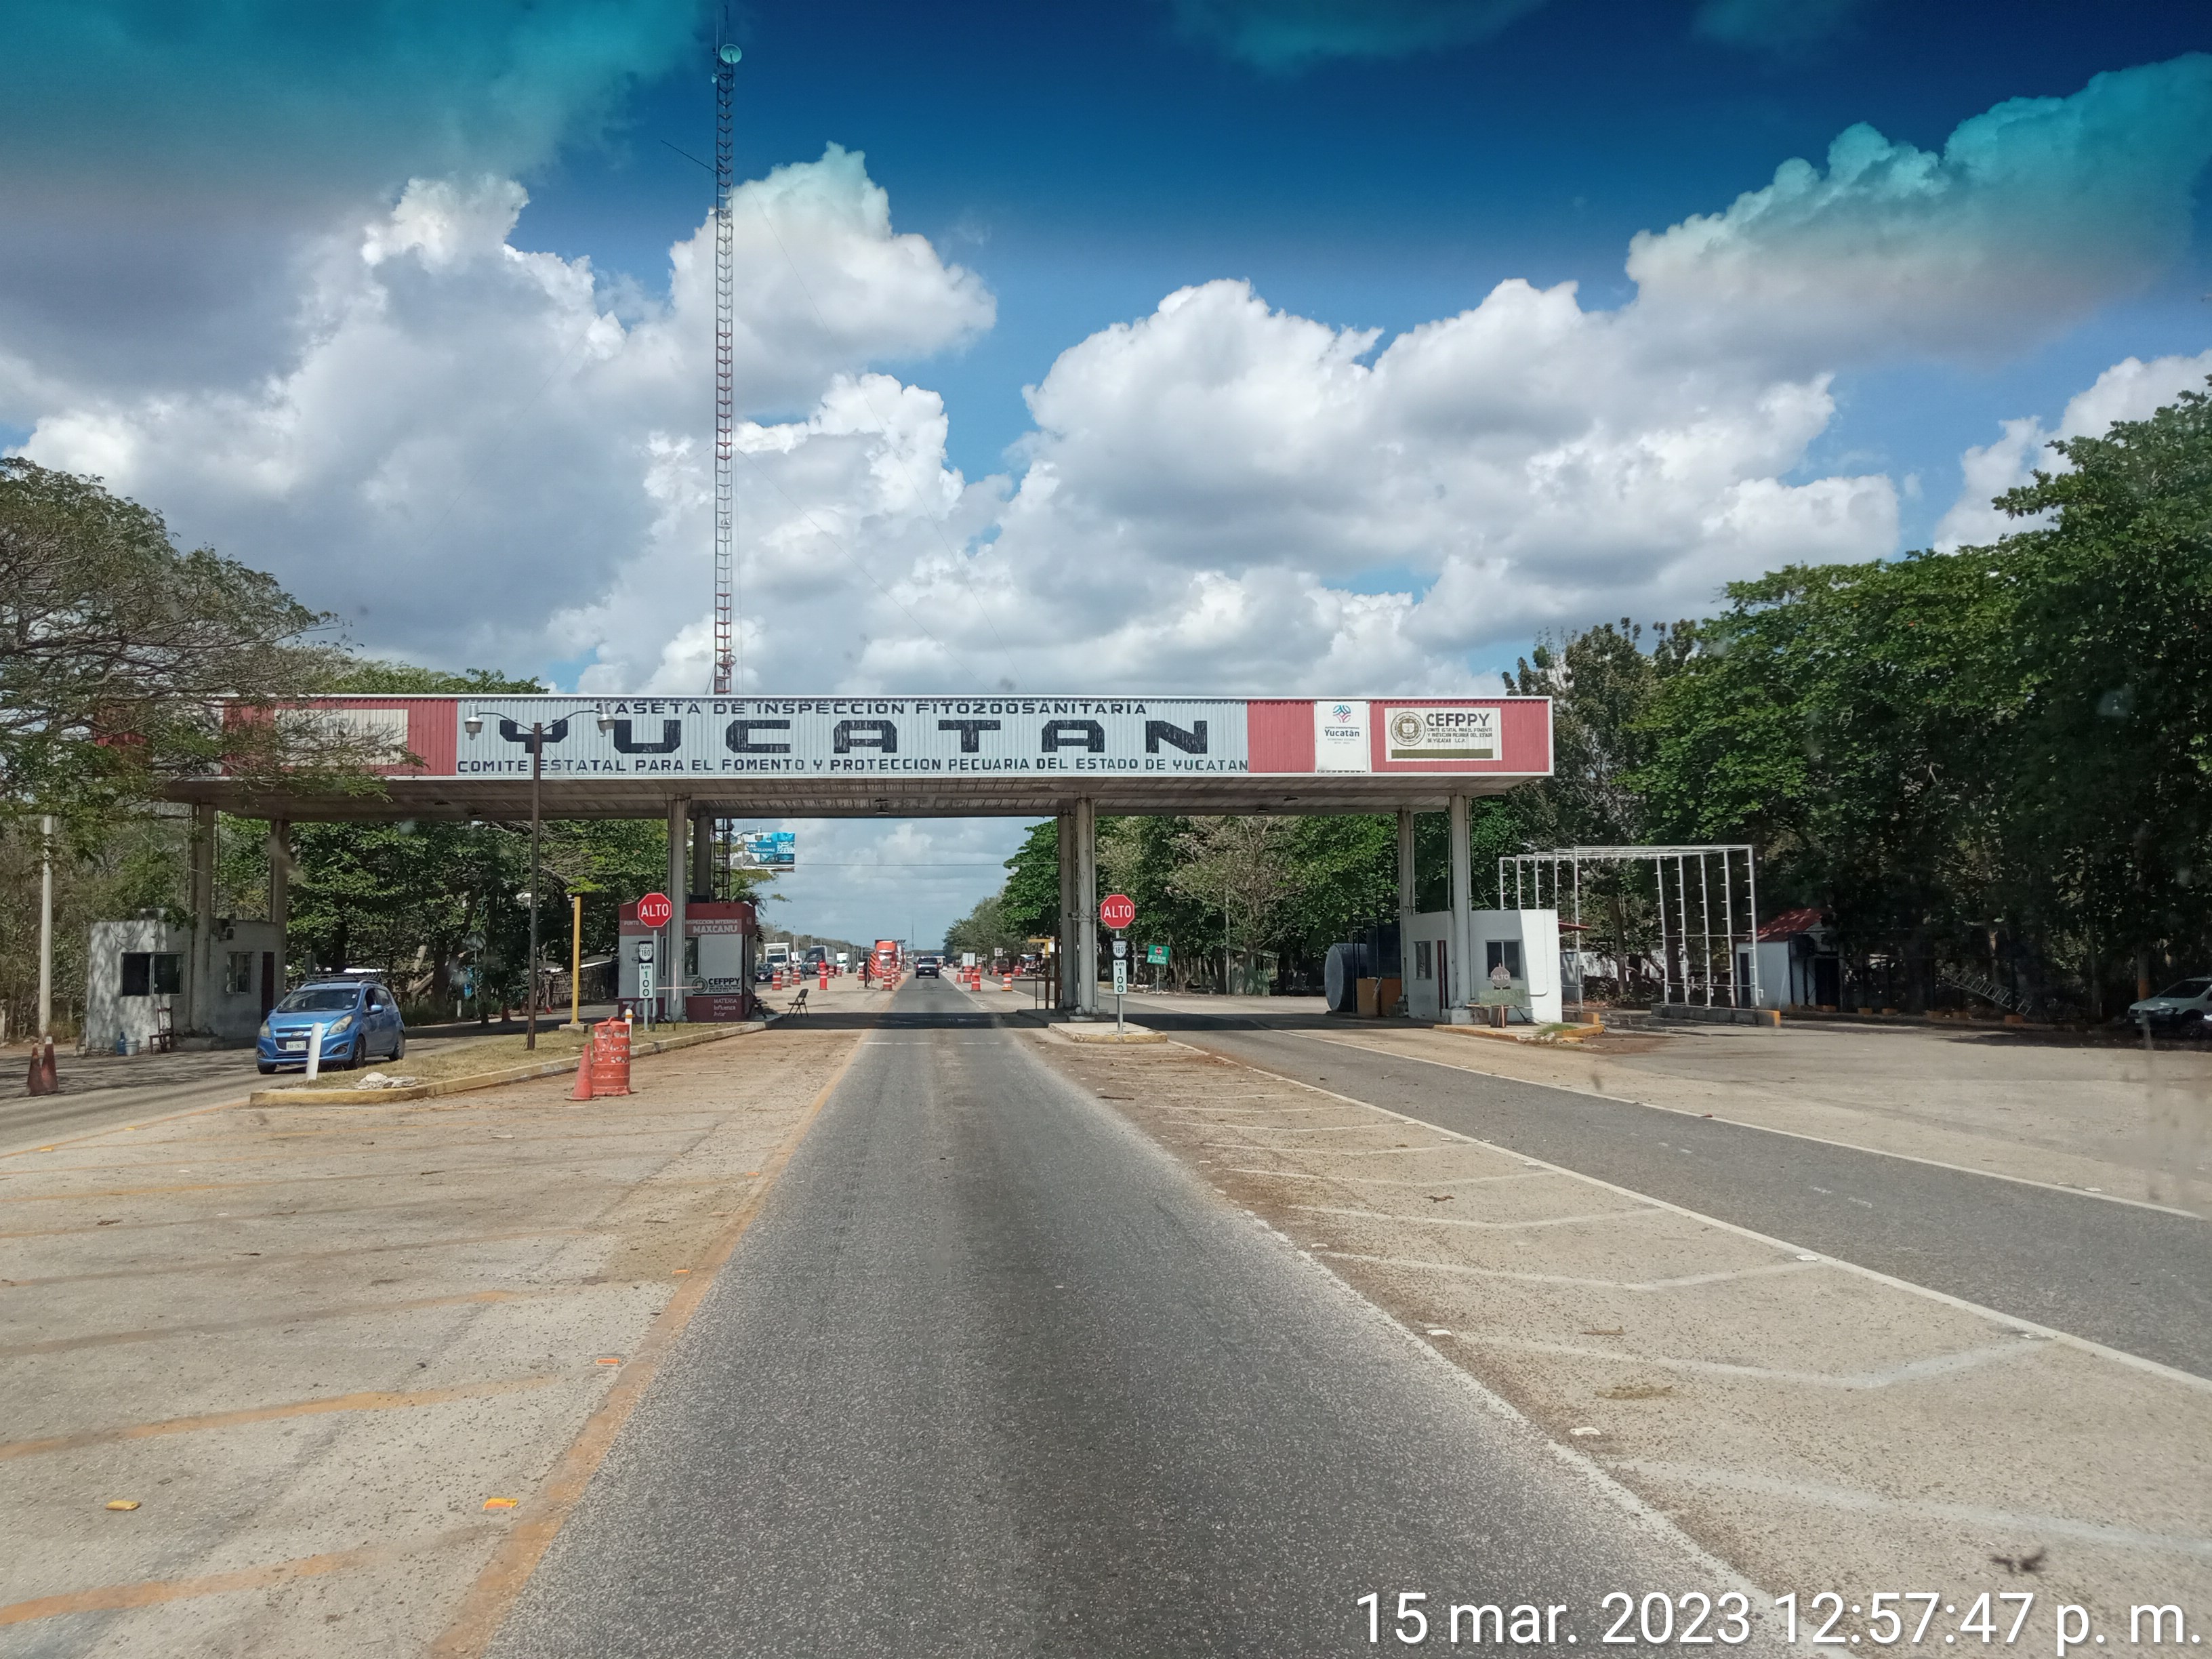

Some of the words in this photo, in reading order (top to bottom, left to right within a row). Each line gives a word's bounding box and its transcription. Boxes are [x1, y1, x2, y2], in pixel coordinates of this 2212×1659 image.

[714, 703, 745, 714] DE
[757, 703, 905, 714] INSPECCION
[916, 703, 1147, 714] FITOZOOSANITARIA
[1426, 713, 1490, 726] CEFPPY
[499, 719, 1208, 754] YUCATAN
[1324, 729, 1360, 737] Yucatán
[457, 760, 528, 772] COMITE
[540, 759, 627, 772] ESTATAL
[636, 759, 684, 771] PARA
[692, 760, 714, 771] EL
[722, 758, 804, 771] FOMENTO
[813, 758, 823, 770] Y
[830, 758, 941, 771] PROTECCION
[949, 758, 1030, 771] PECUARIA
[1036, 758, 1069, 770] DEL
[1076, 758, 1139, 770] ESTADO
[1145, 758, 1166, 770] DE
[1172, 759, 1248, 771] YUCATAN
[640, 903, 669, 918] ALTO
[1103, 905, 1132, 918] ALTO
[693, 924, 738, 933] MAXCANU
[708, 977, 741, 985] CEFPPY
